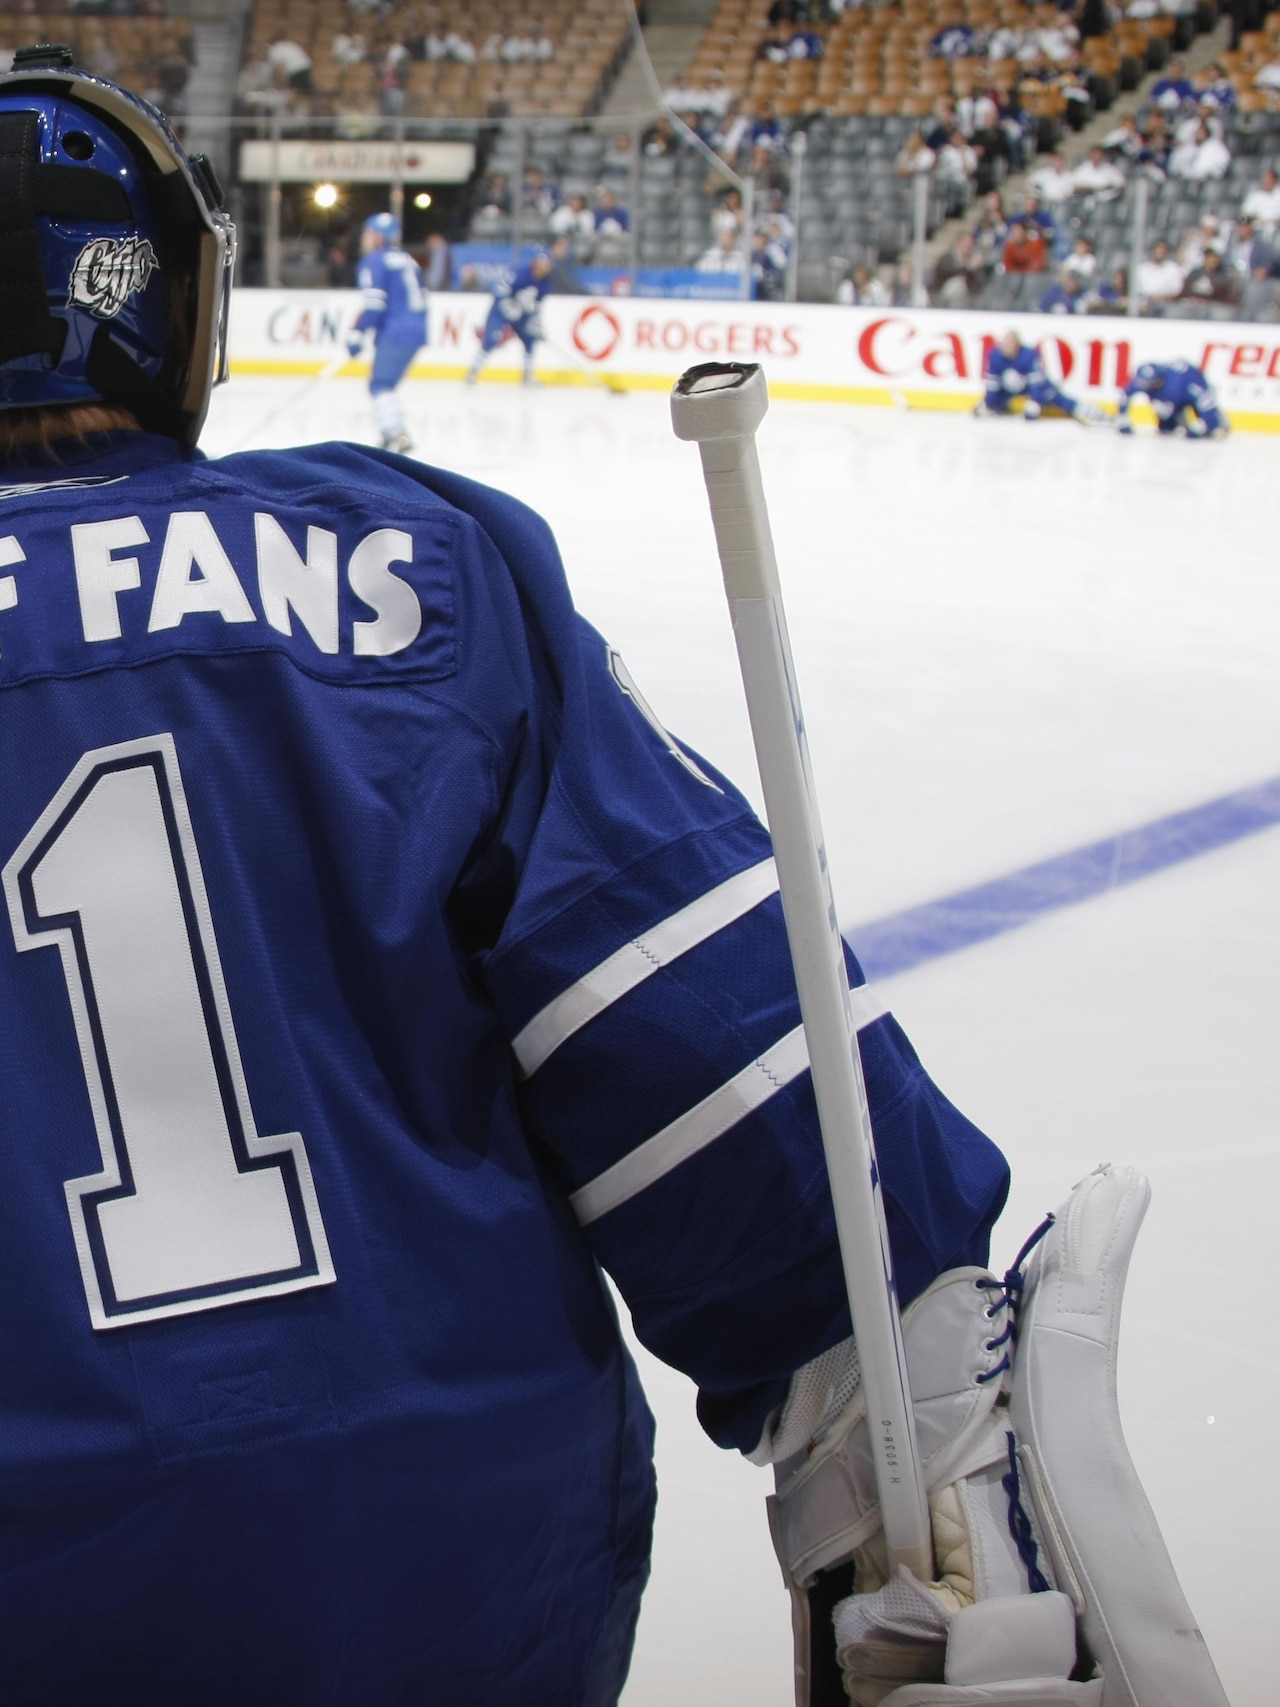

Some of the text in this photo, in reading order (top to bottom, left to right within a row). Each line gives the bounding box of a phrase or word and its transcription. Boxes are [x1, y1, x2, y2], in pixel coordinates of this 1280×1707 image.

[635, 319, 800, 357] ROGERS
[71, 511, 422, 656] FANS
[1, 732, 338, 1331] 1
